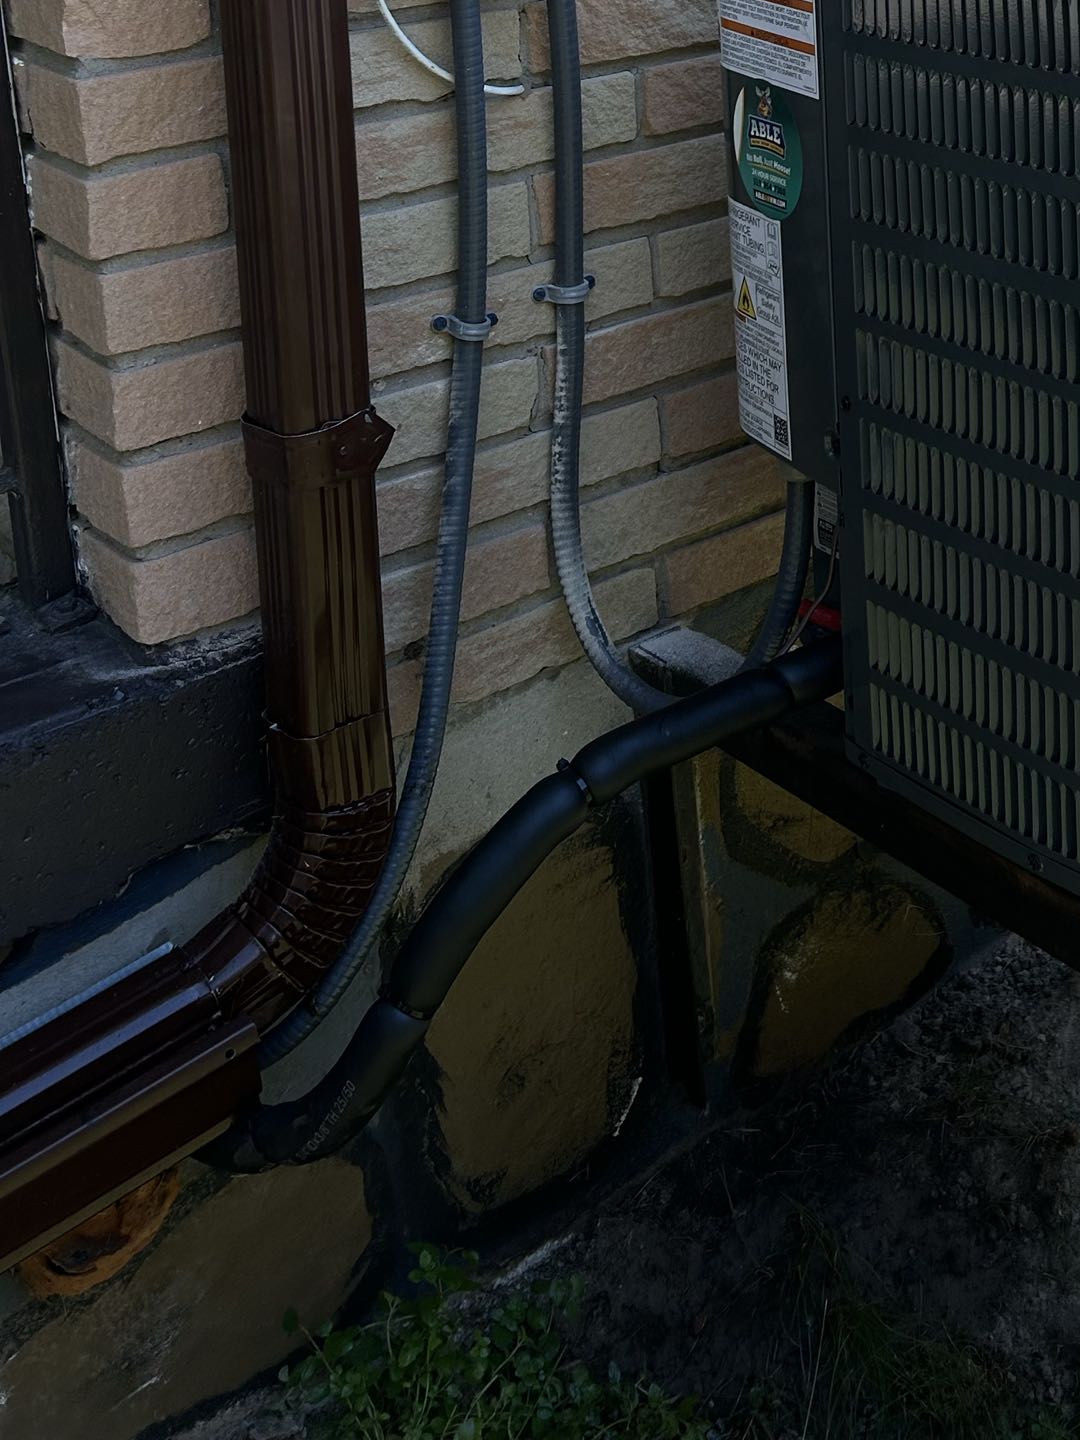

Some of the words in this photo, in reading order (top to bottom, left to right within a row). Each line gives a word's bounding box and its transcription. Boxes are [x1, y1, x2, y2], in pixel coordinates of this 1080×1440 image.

[750, 119, 781, 145] ABLE
[742, 234, 765, 254] TUBING
[748, 346, 768, 366] WHICH
[769, 358, 781, 372] MAY
[759, 363, 772, 380] THE
[746, 366, 765, 386] LISTED
[766, 379, 779, 395] FOR
[334, 1080, 356, 1113] 25/50
